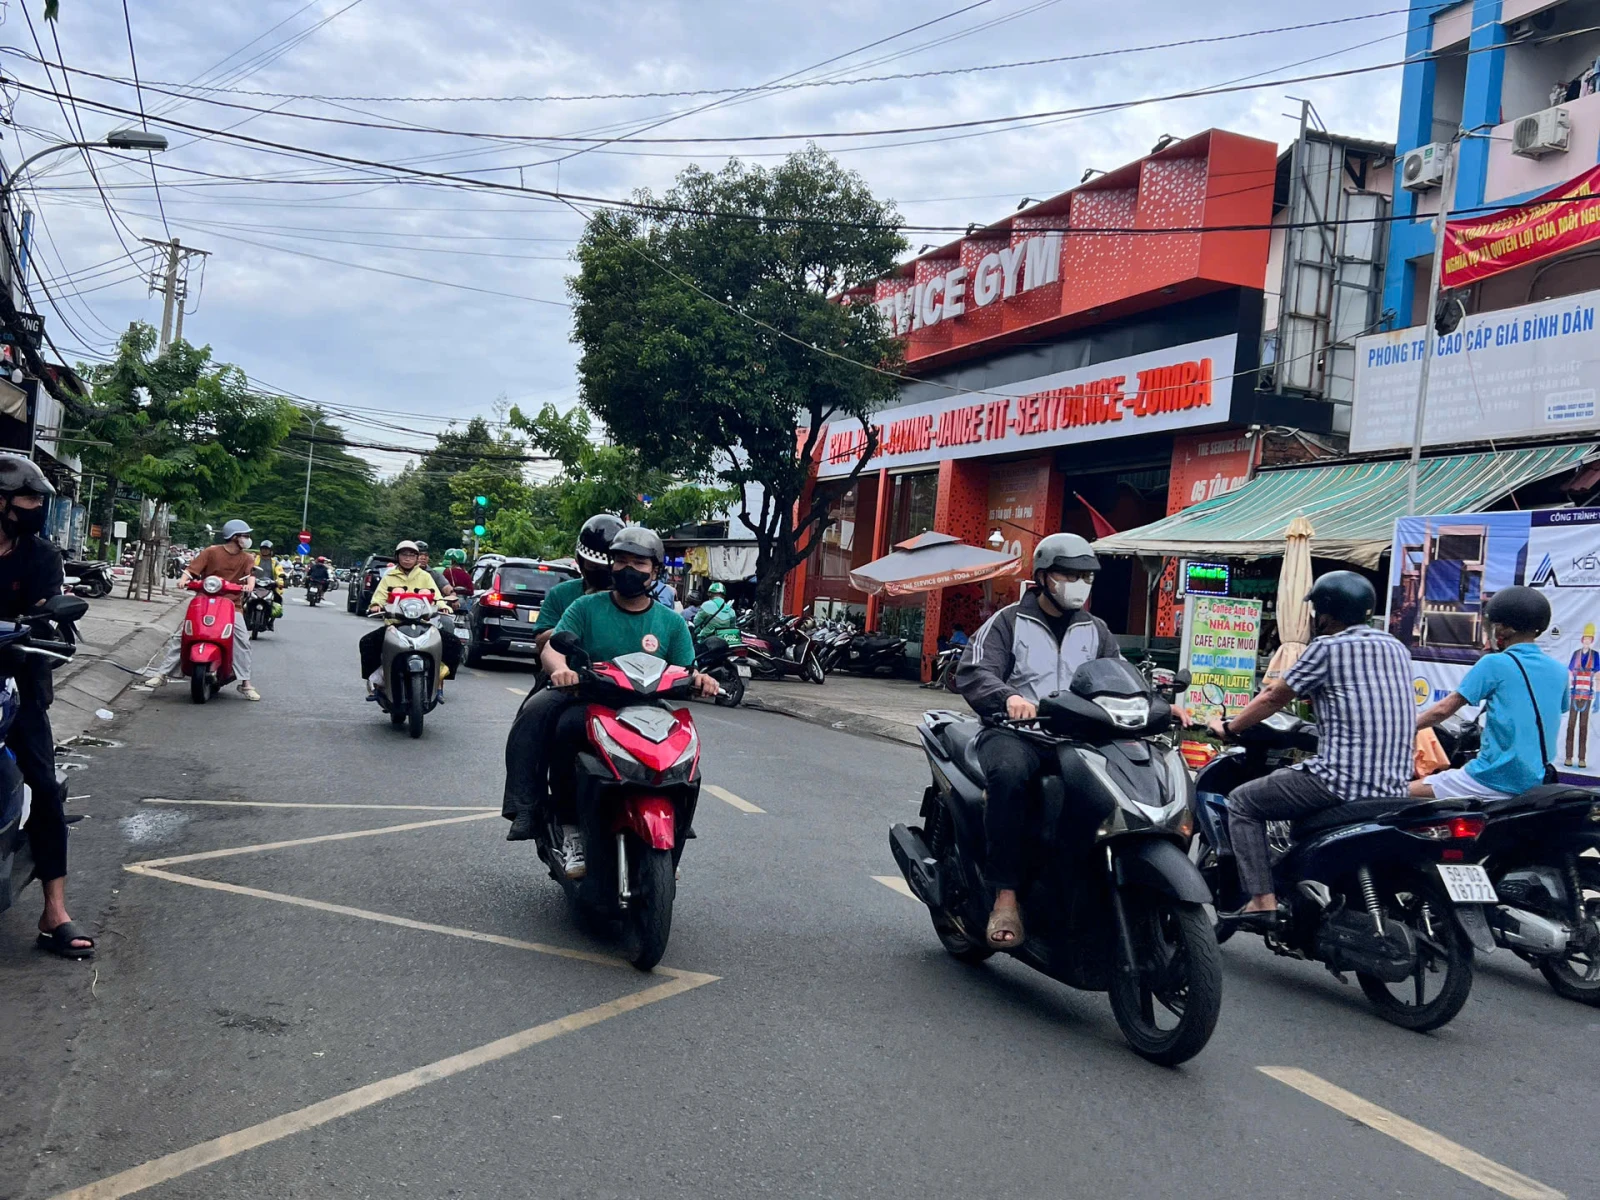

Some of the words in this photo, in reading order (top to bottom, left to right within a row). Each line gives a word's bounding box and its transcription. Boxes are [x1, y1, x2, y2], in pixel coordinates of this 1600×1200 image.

[1535, 217, 1557, 240] CỦA
[974, 231, 1065, 307] GYM
[1411, 341, 1434, 361] TR
[1437, 333, 1462, 356] CAO
[1465, 320, 1492, 351] CẤP
[1495, 317, 1519, 346] GIÁ
[1523, 313, 1559, 340] BÌNH
[1562, 305, 1595, 335] DÂN
[1550, 512, 1571, 522] CÔNG
[902, 582, 913, 590] THE
[913, 577, 936, 588] SERVICE
[936, 575, 950, 585] GYM
[1211, 603, 1232, 615] Coffee
[1233, 605, 1246, 616] And
[1247, 606, 1258, 617] Tea
[1216, 636, 1236, 649] CAFE
[1191, 672, 1225, 687] MATCHA
[1226, 675, 1250, 689] LATTE
